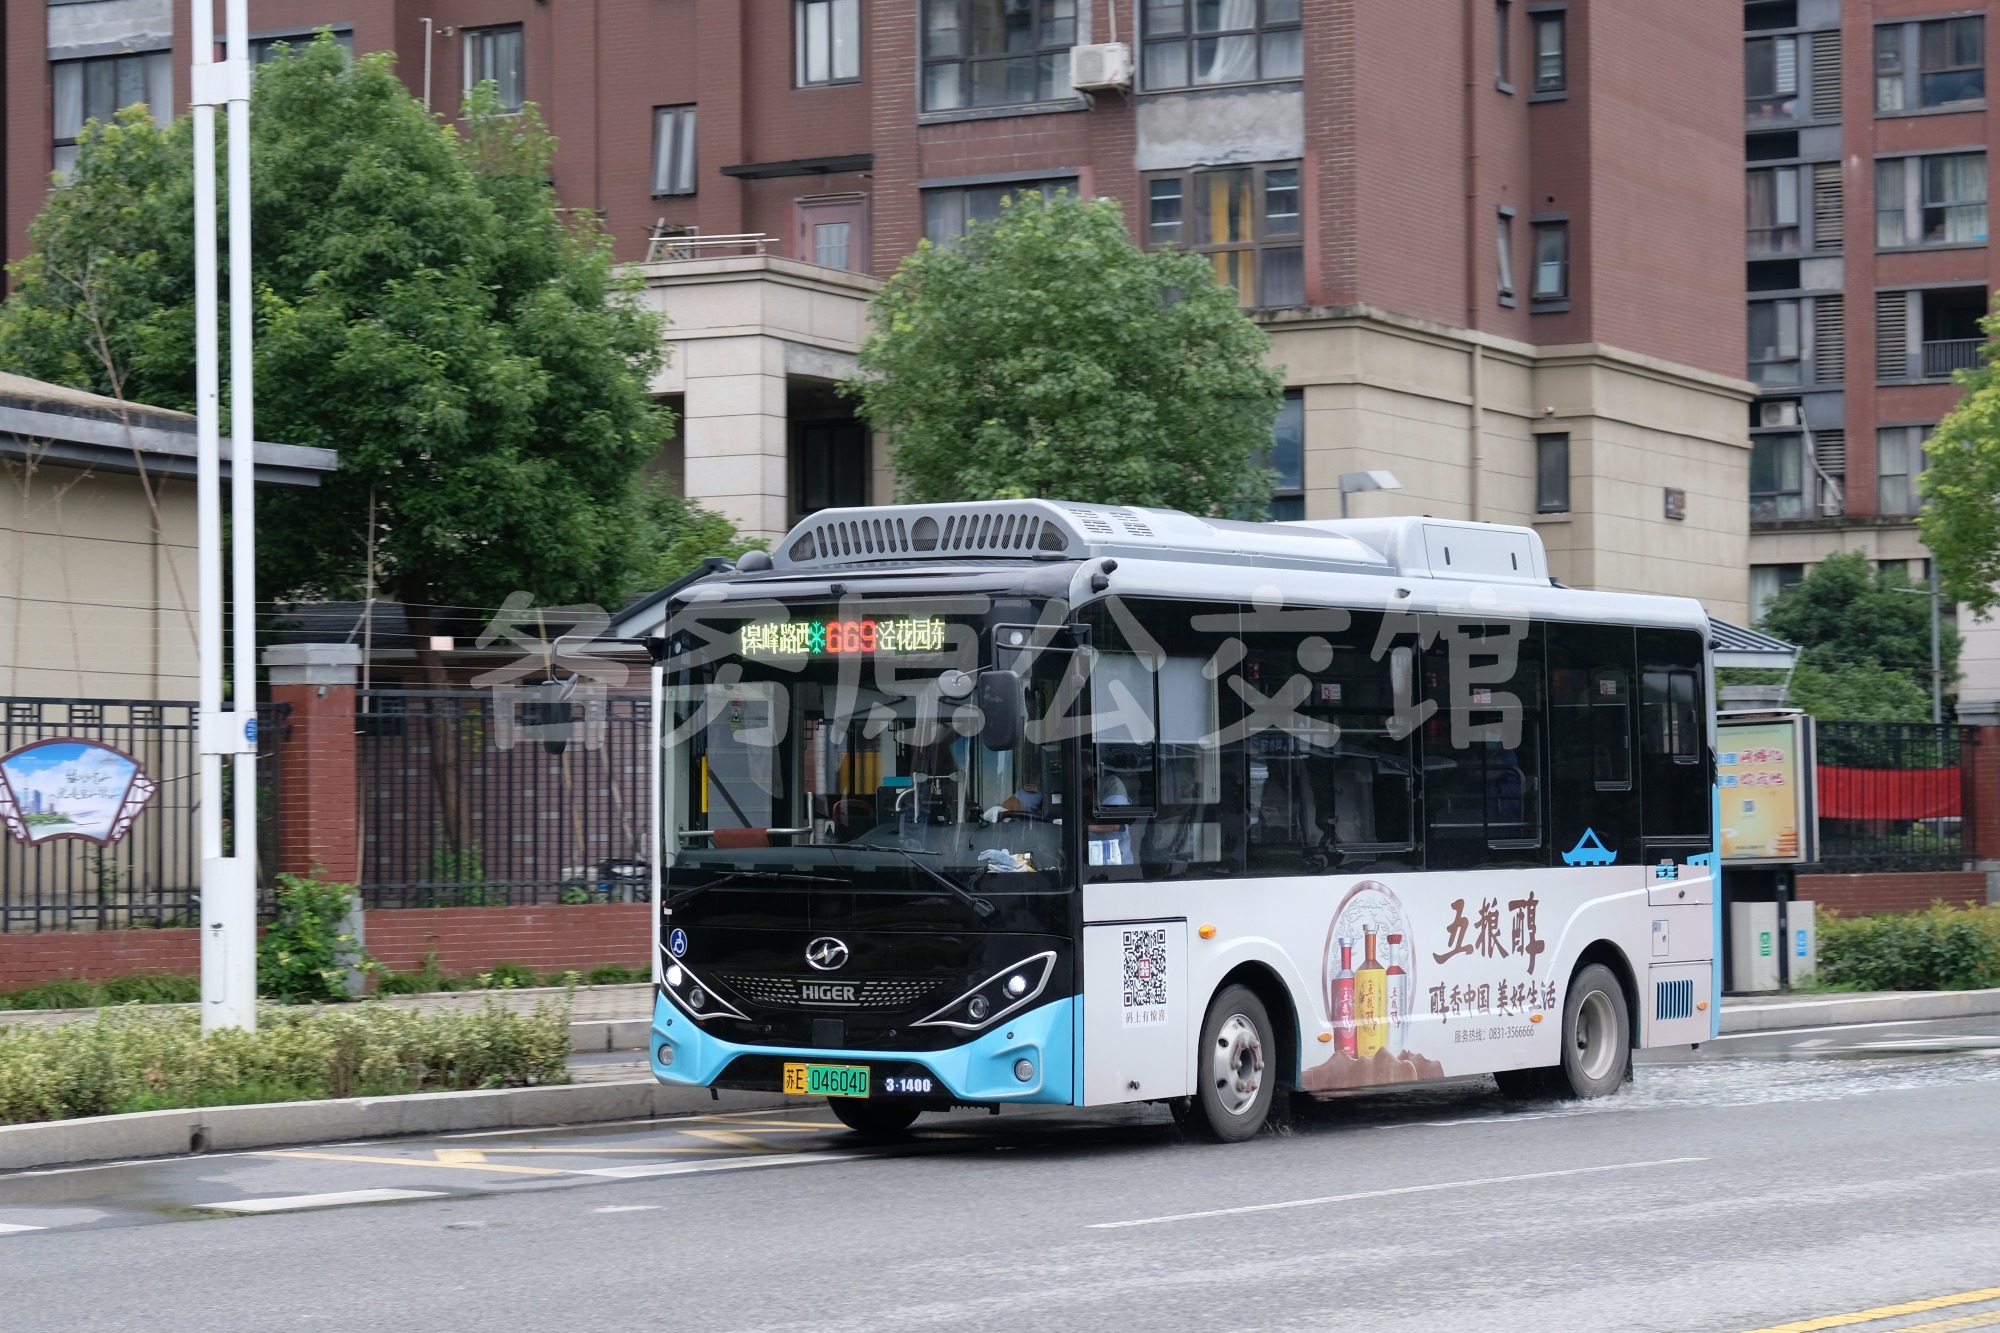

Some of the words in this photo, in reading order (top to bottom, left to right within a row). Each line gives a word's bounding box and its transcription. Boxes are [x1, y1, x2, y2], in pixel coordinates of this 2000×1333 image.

[741, 622, 810, 655] 皋峰路西
[825, 620, 876, 653] 669
[1432, 891, 1546, 975] 五粮醇
[802, 985, 856, 1001] HIGER
[1496, 978, 1556, 1017] 美好生活
